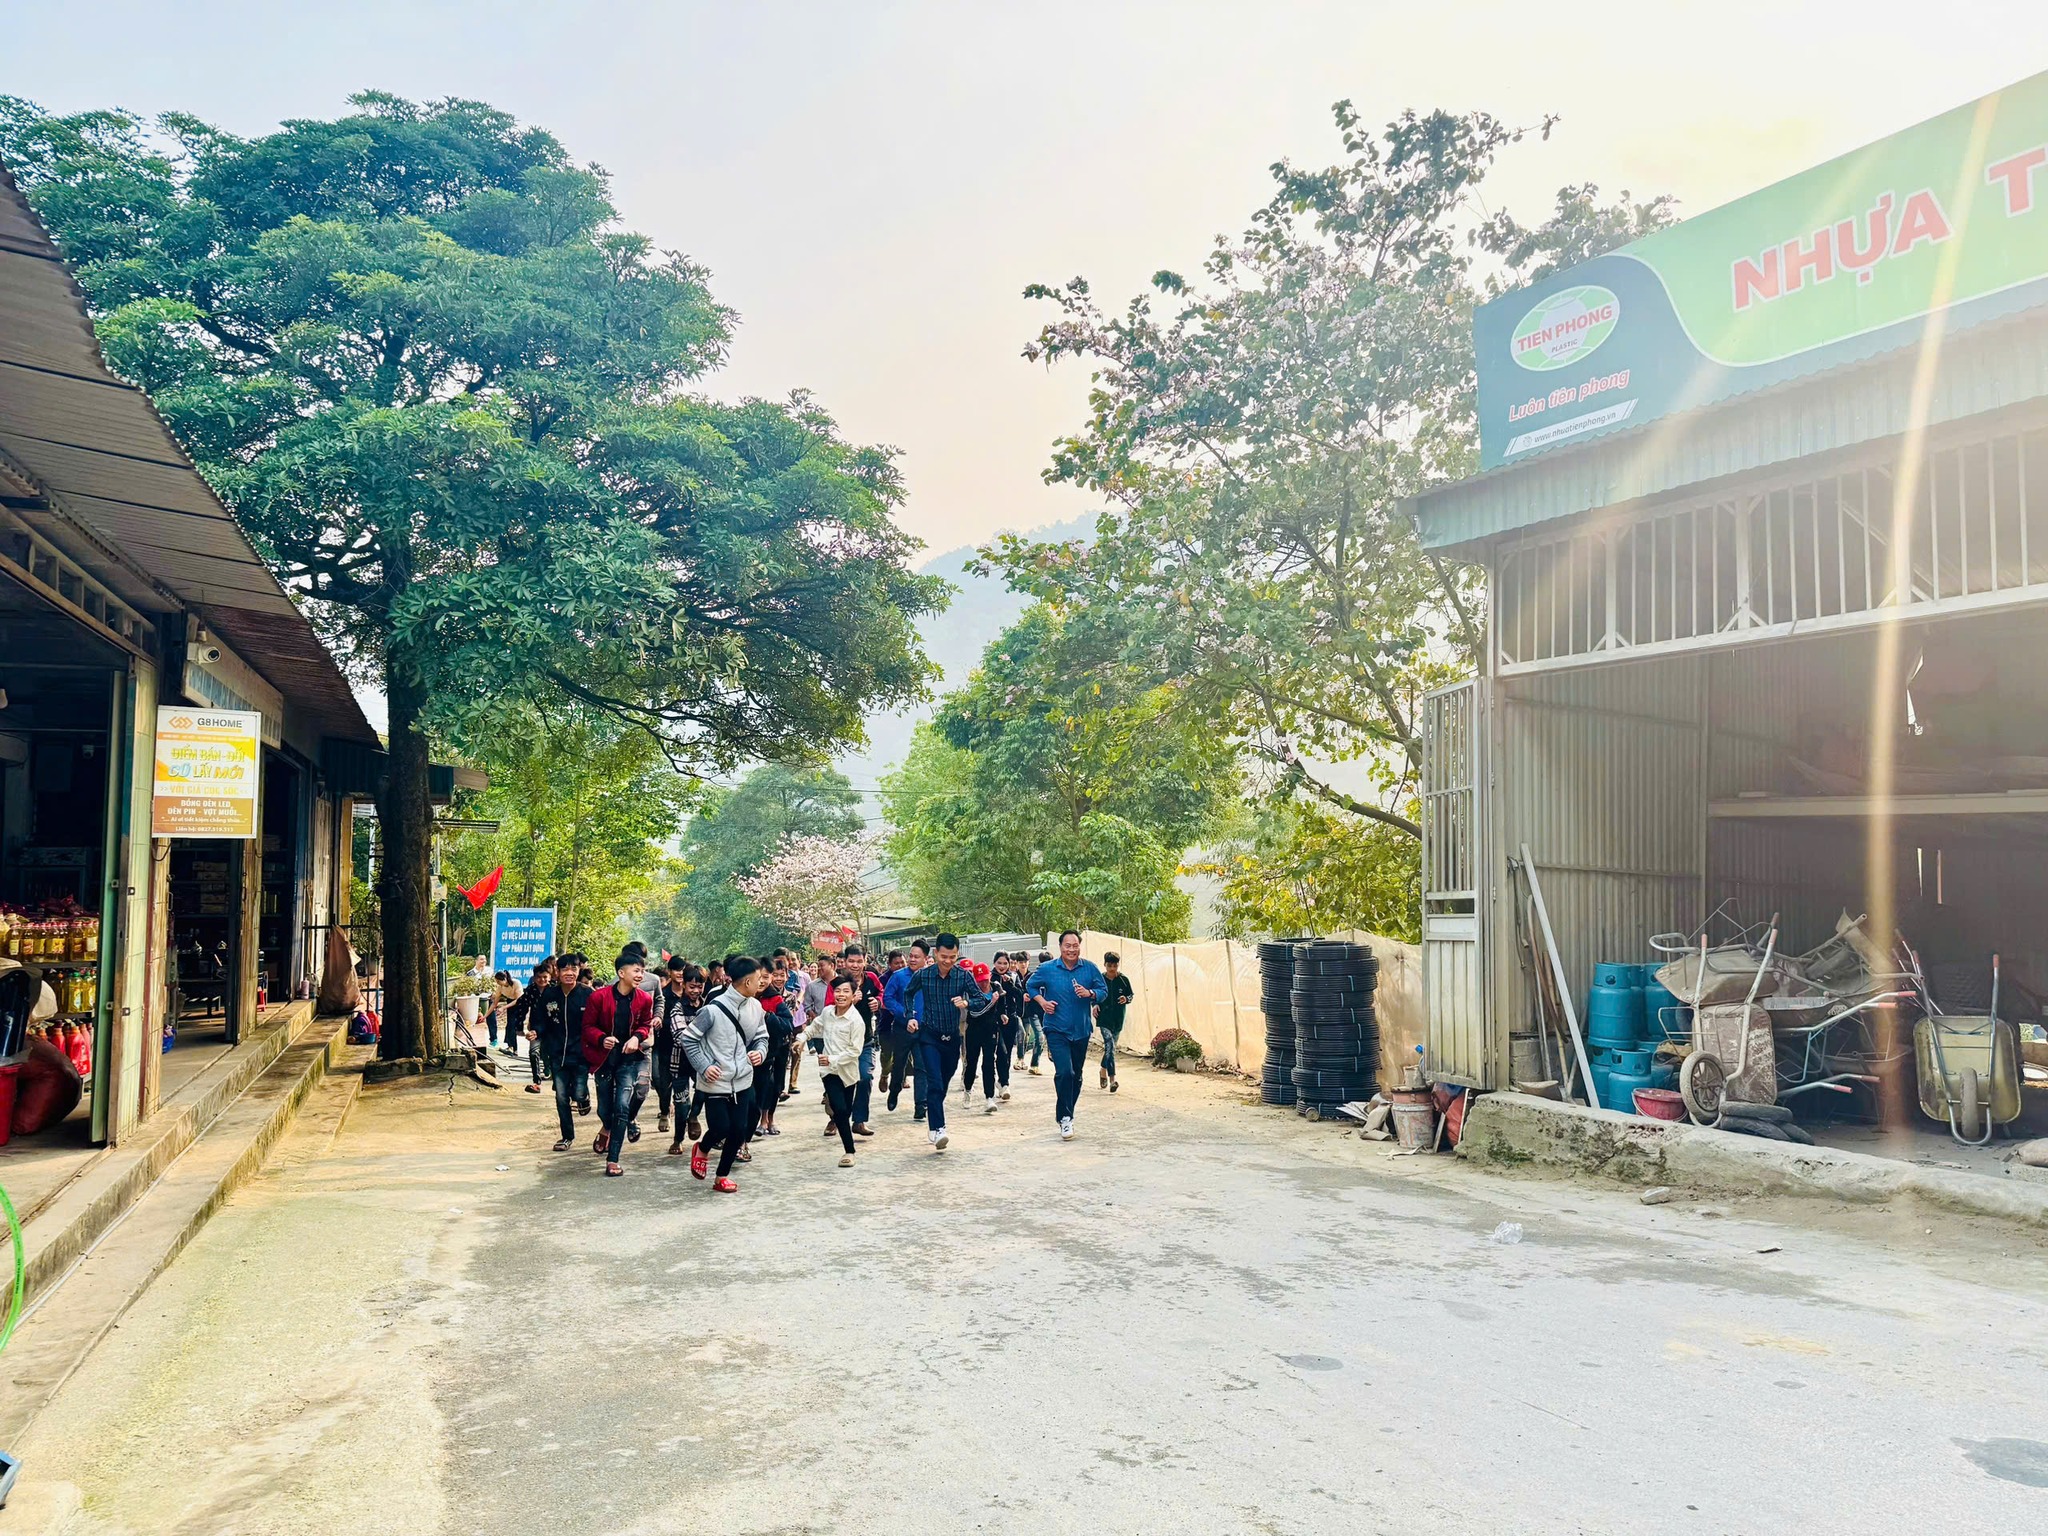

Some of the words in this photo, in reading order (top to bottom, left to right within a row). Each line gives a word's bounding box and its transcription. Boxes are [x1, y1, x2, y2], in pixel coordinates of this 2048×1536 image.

[1732, 189, 1952, 311] NHỰA
[1517, 328, 1552, 352] TIEN
[1554, 305, 1613, 338] PHONG
[1551, 338, 1578, 353] PLASTIC
[1509, 398, 1545, 422] Luôn
[1579, 369, 1630, 402] phong
[1534, 412, 1616, 443] www.nhuatienphong.vn
[167, 807, 181, 815] ĐÈN
[181, 798, 201, 807] BÓNG
[202, 799, 217, 807] ĐÈN
